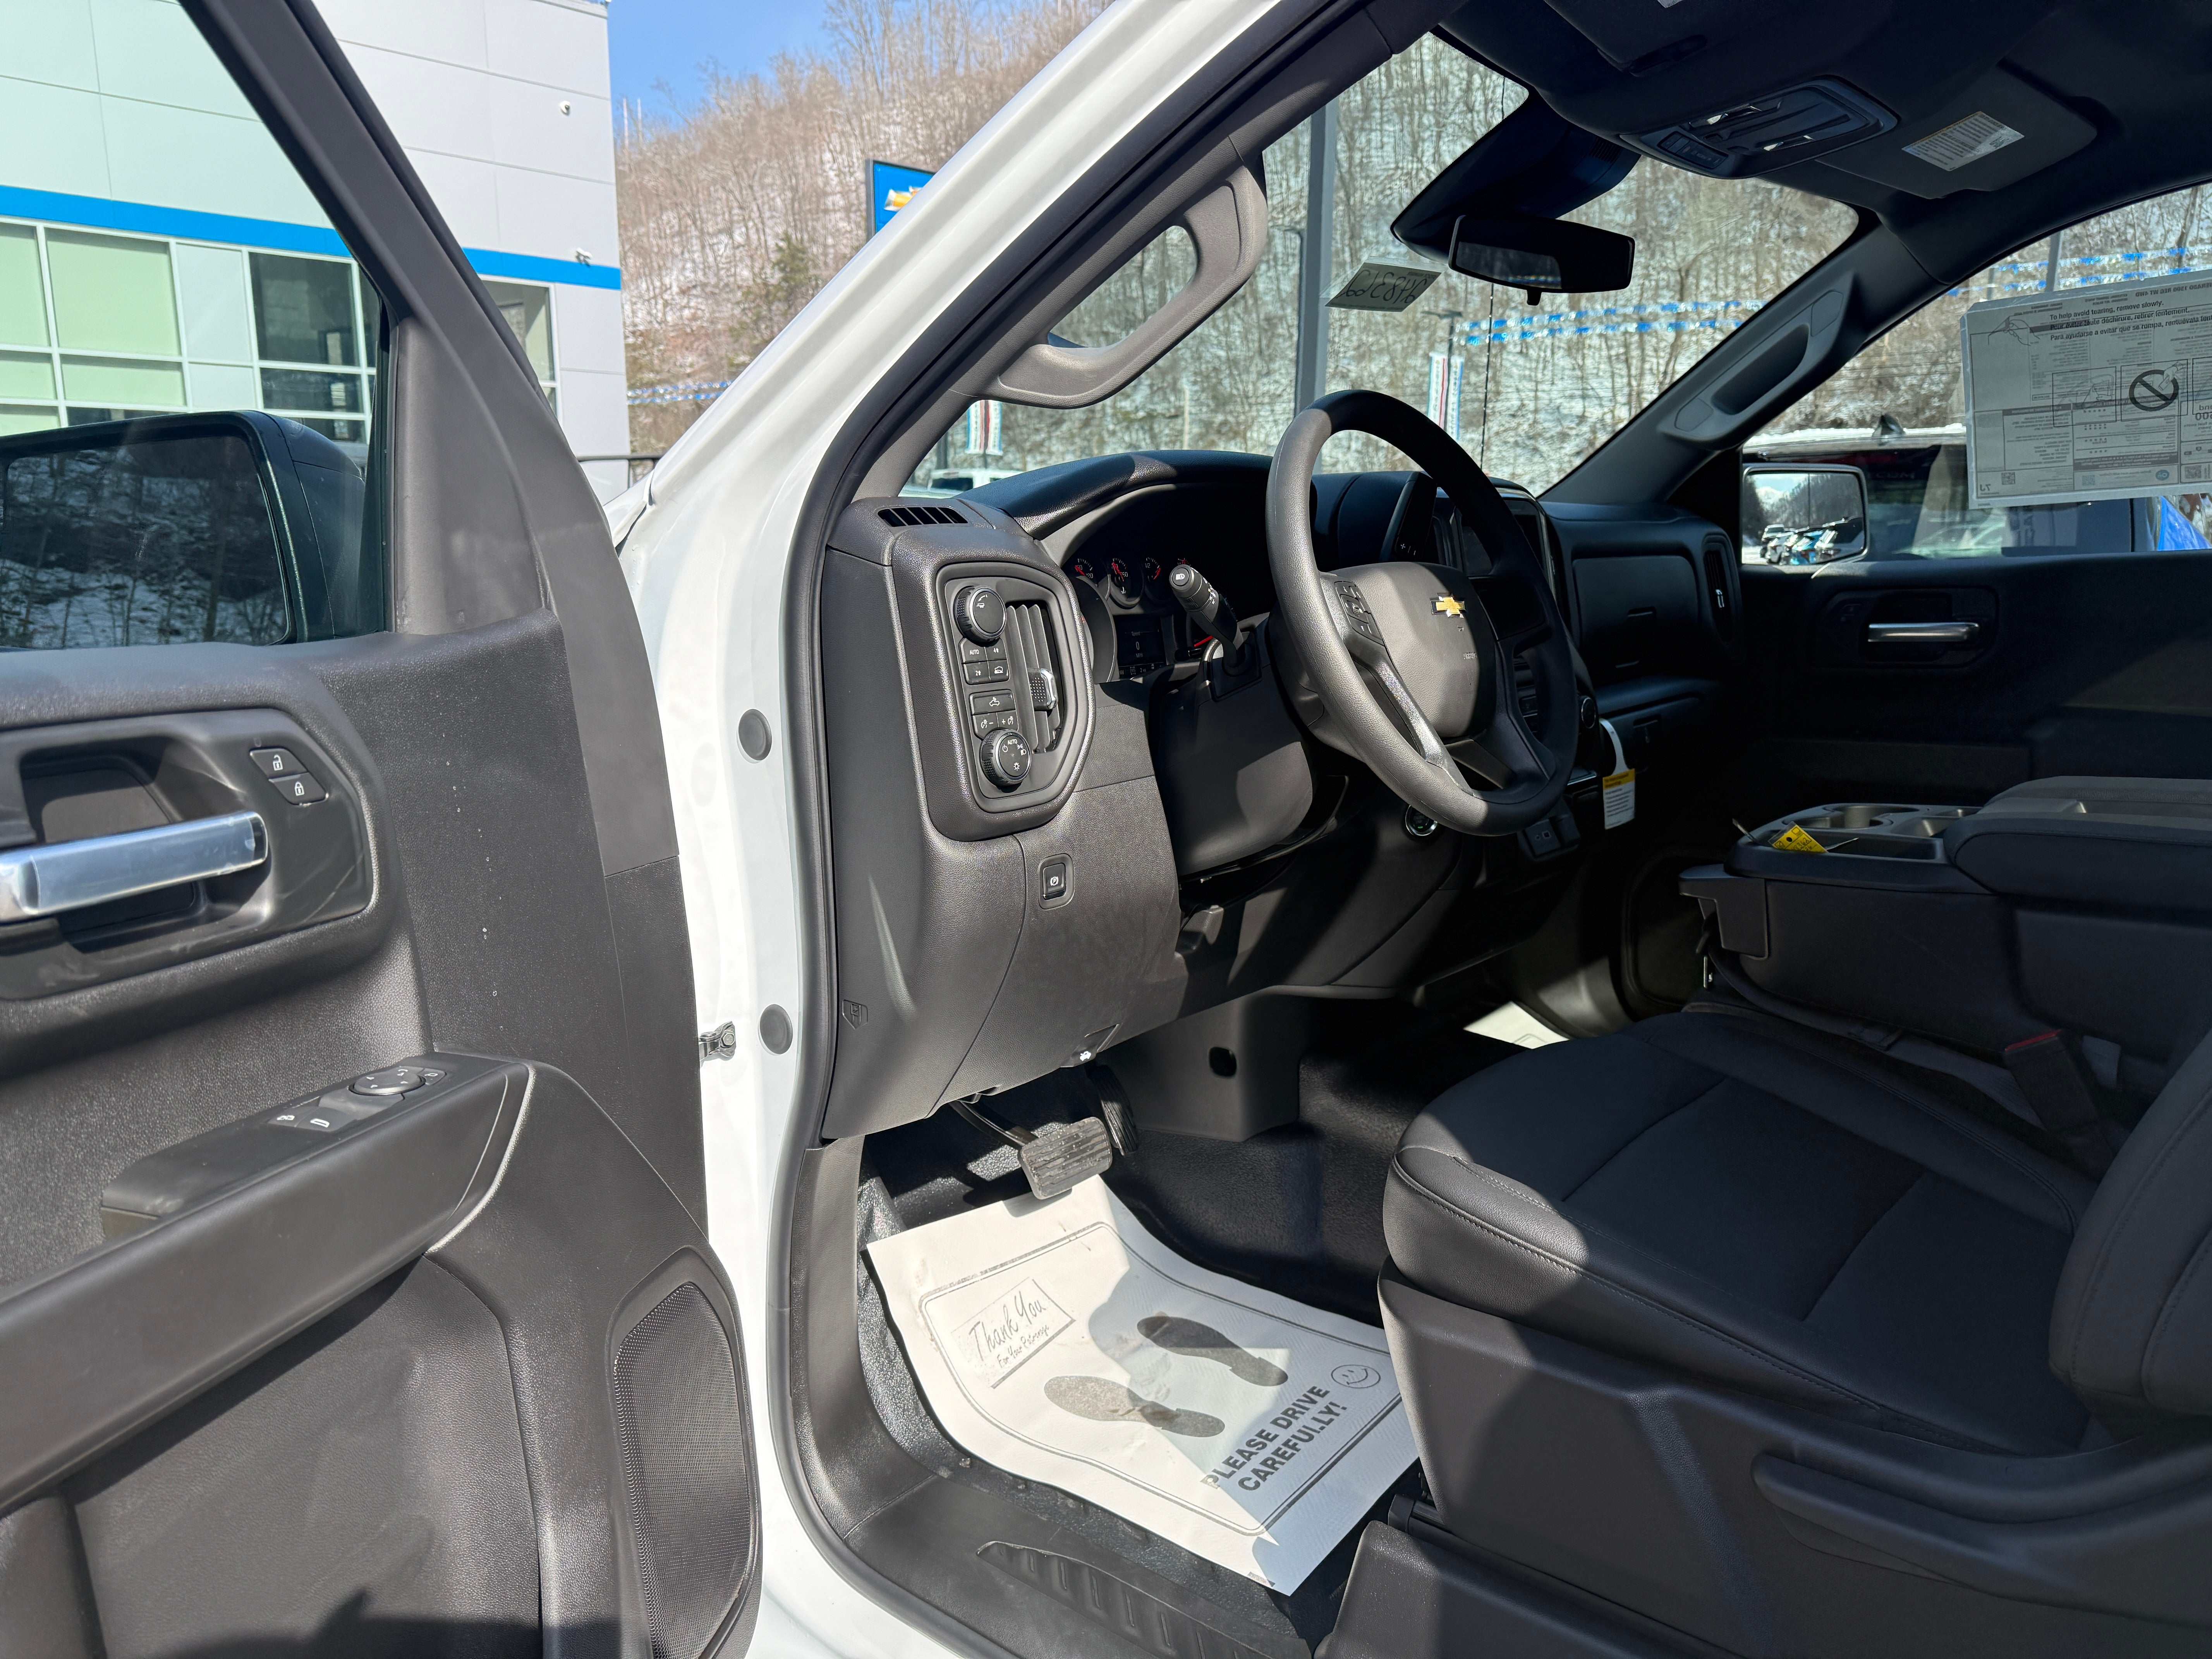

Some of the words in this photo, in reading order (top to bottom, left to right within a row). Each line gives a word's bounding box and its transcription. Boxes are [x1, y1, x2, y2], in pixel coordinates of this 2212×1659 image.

[2066, 331, 2093, 339] ayudarse
[1135, 641, 1140, 650] 0
[969, 1304, 1018, 1361] Thank
[1014, 1291, 1046, 1325] You
[997, 1354, 1009, 1368] For
[1008, 1345, 1023, 1358] Your
[1200, 1428, 1279, 1489] PLEASE
[1269, 1386, 1330, 1429] DRIVE
[1238, 1401, 1347, 1491] CAREFULLY!
